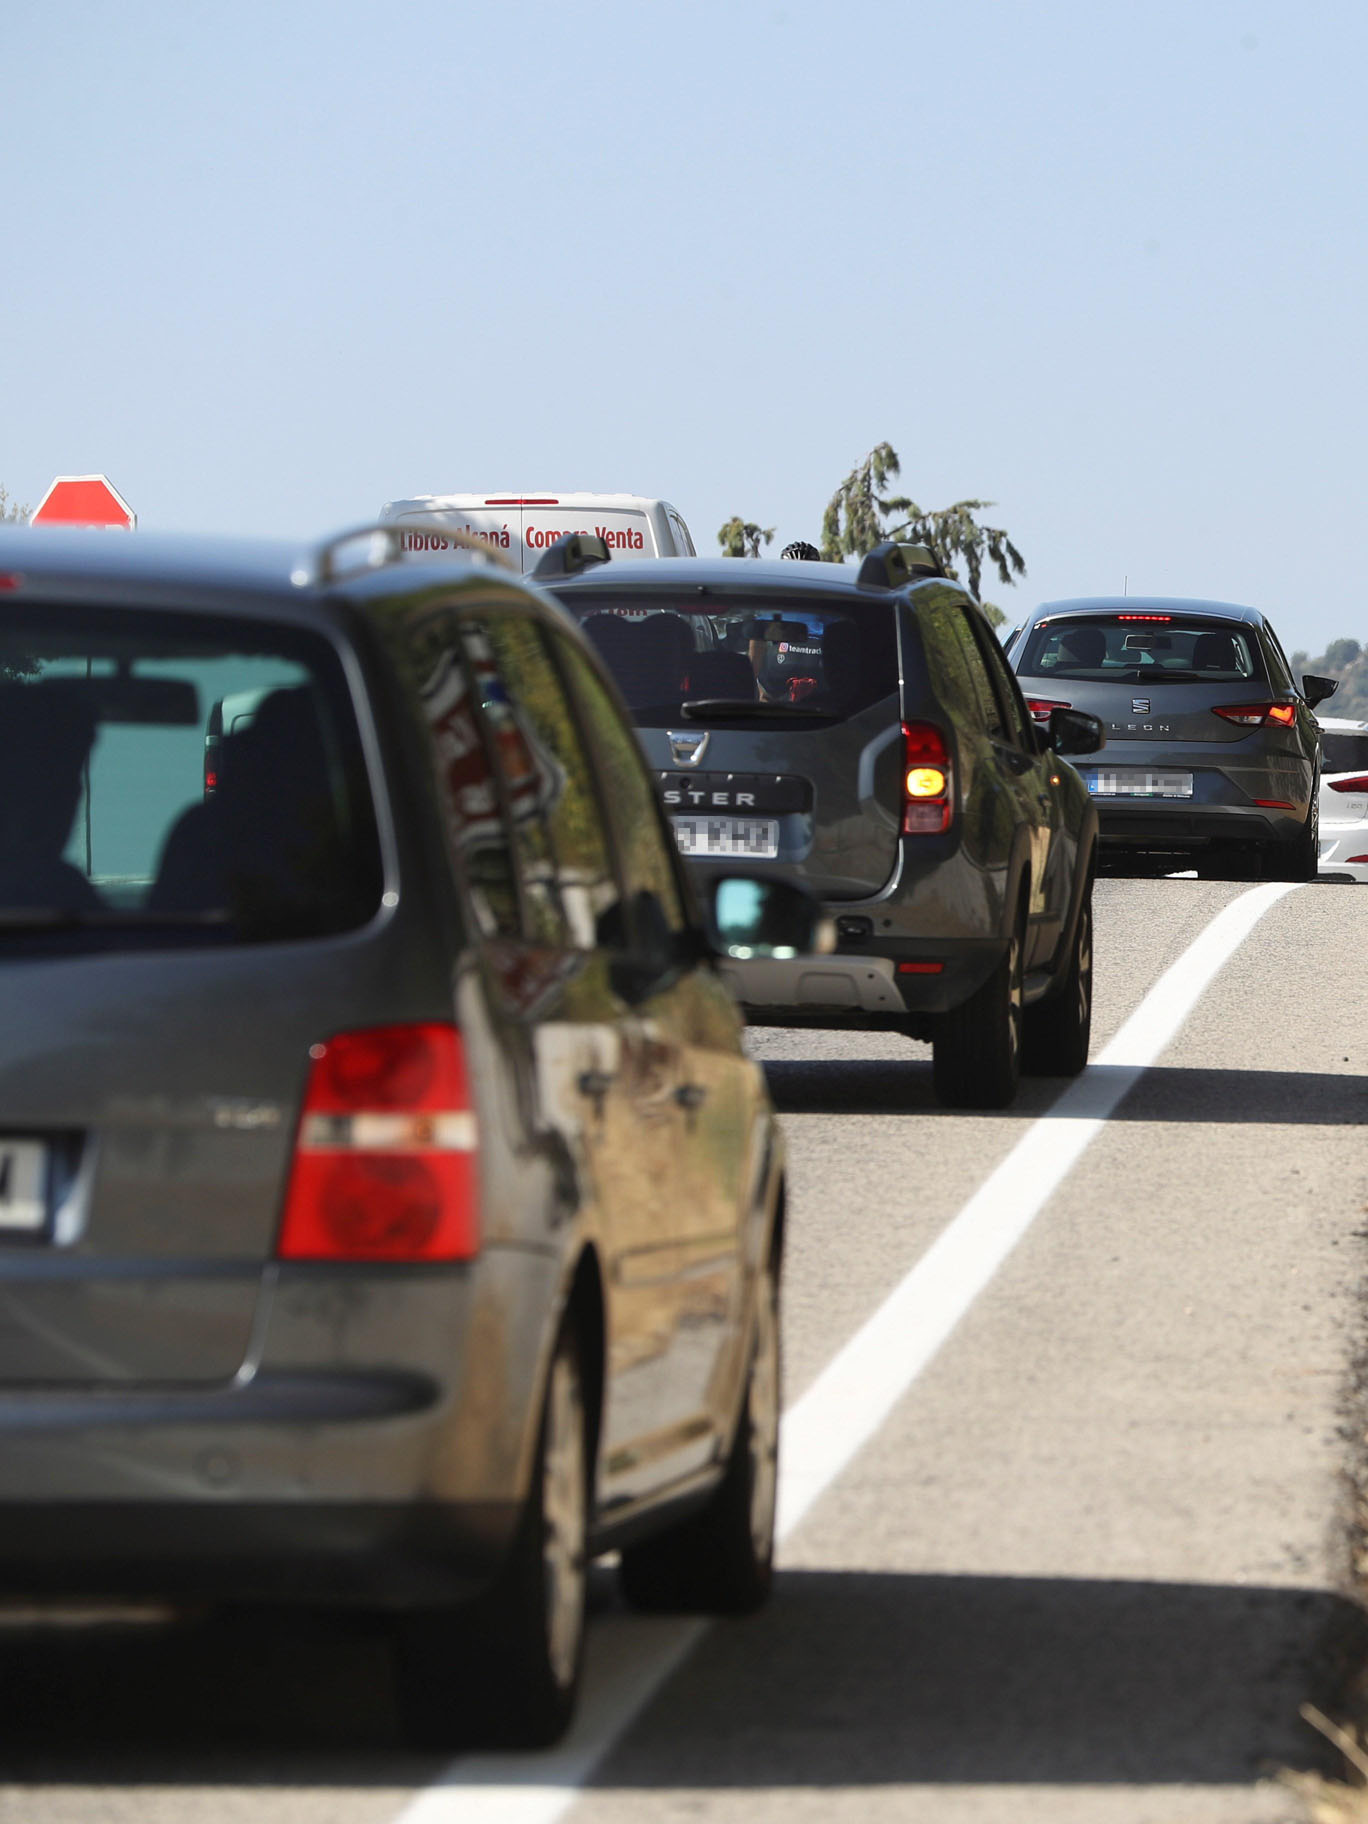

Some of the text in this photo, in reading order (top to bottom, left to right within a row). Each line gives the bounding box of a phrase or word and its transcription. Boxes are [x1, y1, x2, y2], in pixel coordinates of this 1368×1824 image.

[401, 528, 449, 552] Libros
[525, 526, 643, 549] Com Venta
[1111, 723, 1170, 732] LEON
